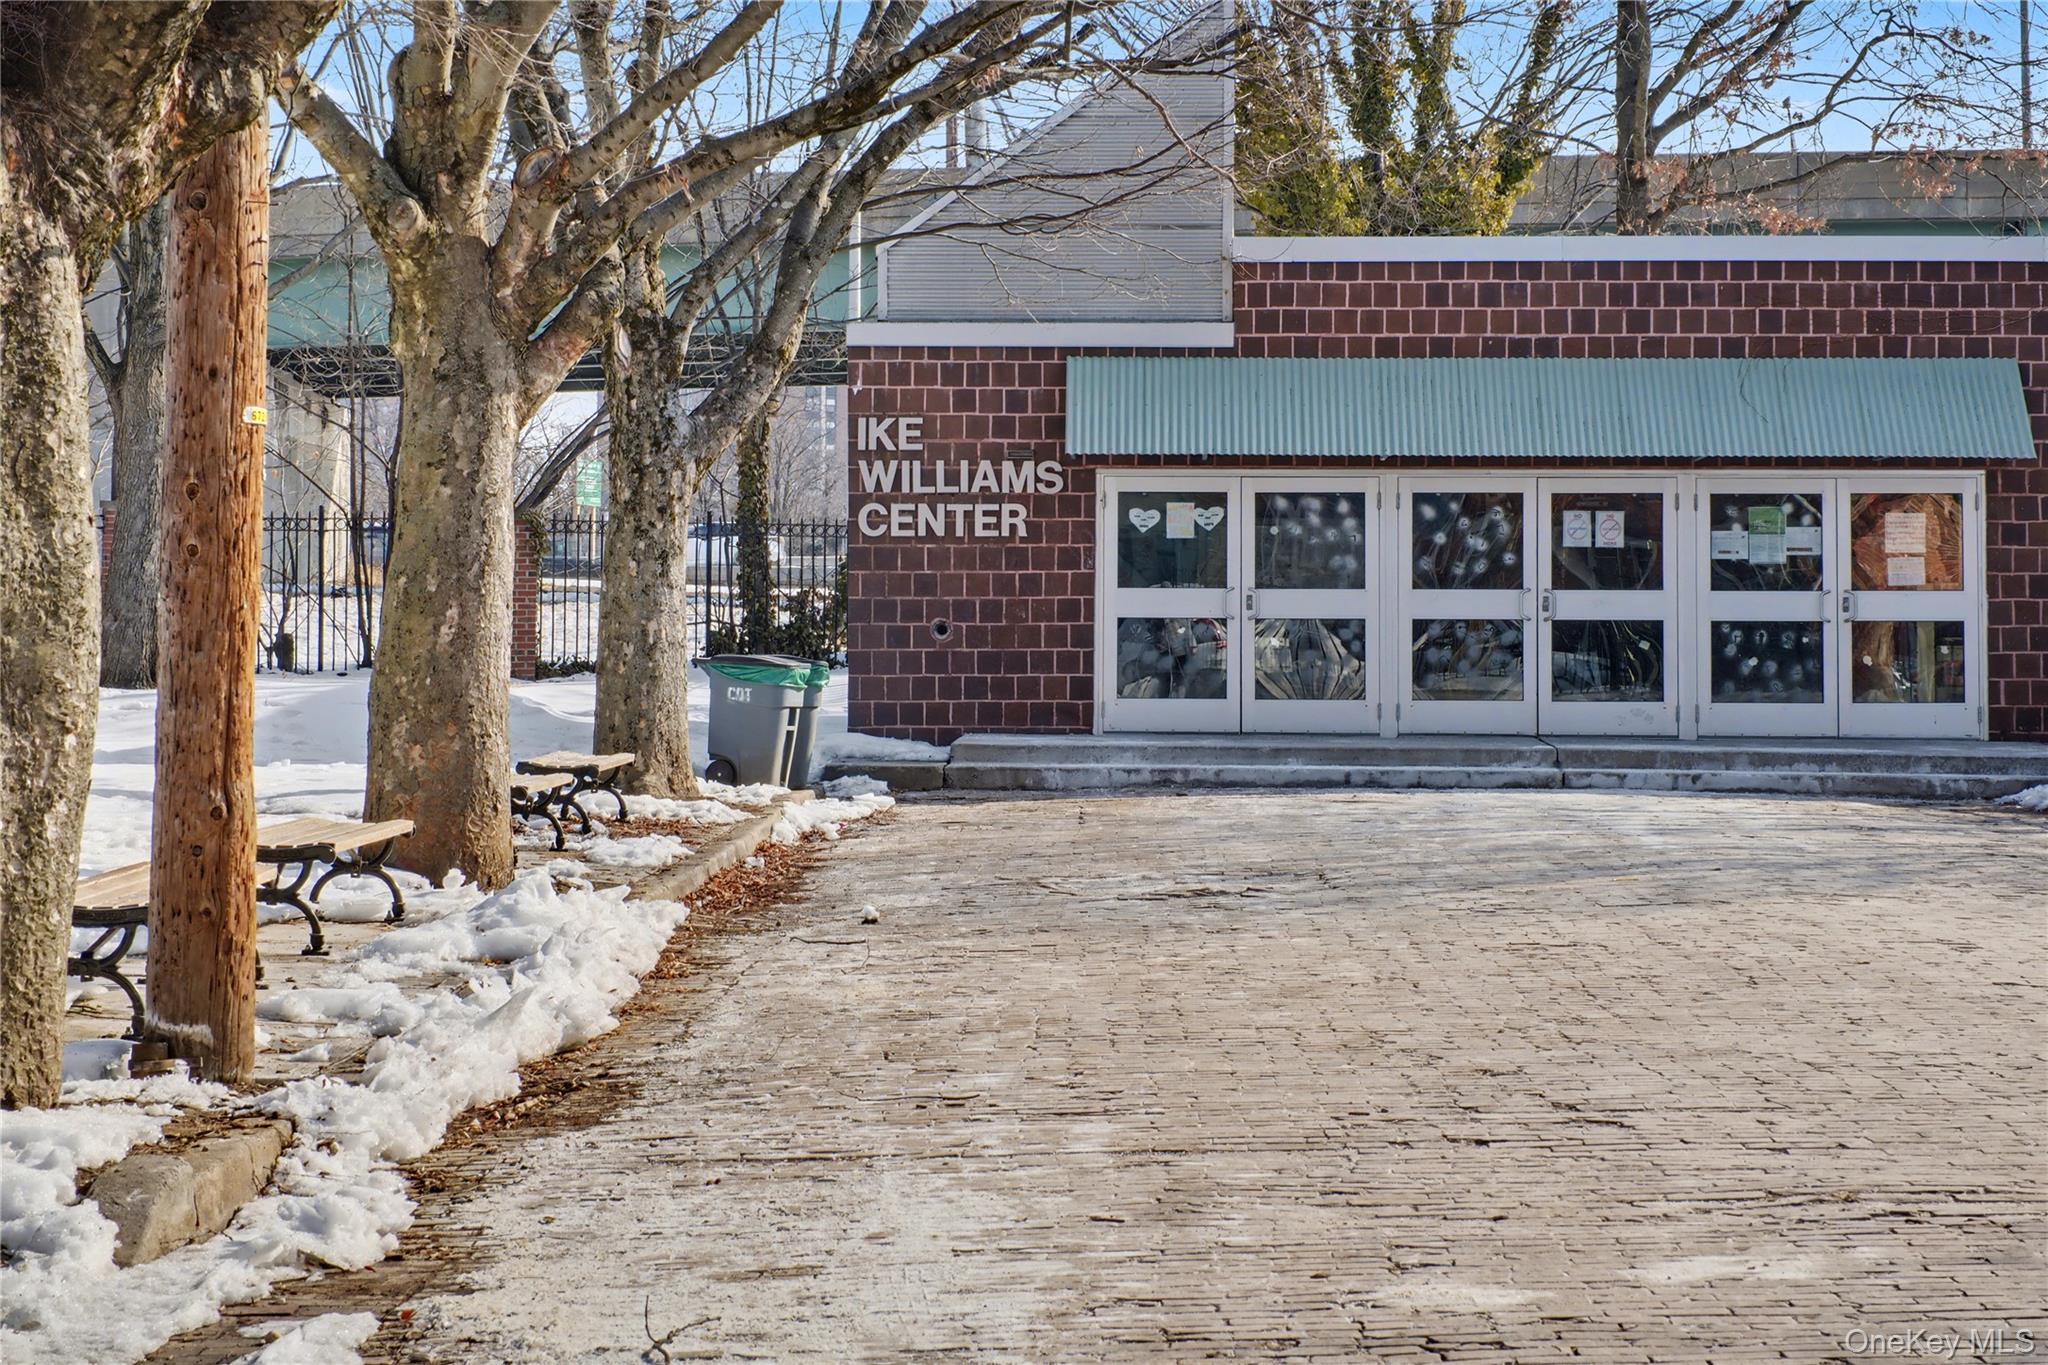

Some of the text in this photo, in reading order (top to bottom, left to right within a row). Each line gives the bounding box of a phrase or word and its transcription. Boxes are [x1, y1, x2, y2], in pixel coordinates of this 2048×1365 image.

[857, 417, 924, 450] IKE
[858, 460, 1064, 495] WILLIAMS
[857, 503, 1028, 537] CENTER
